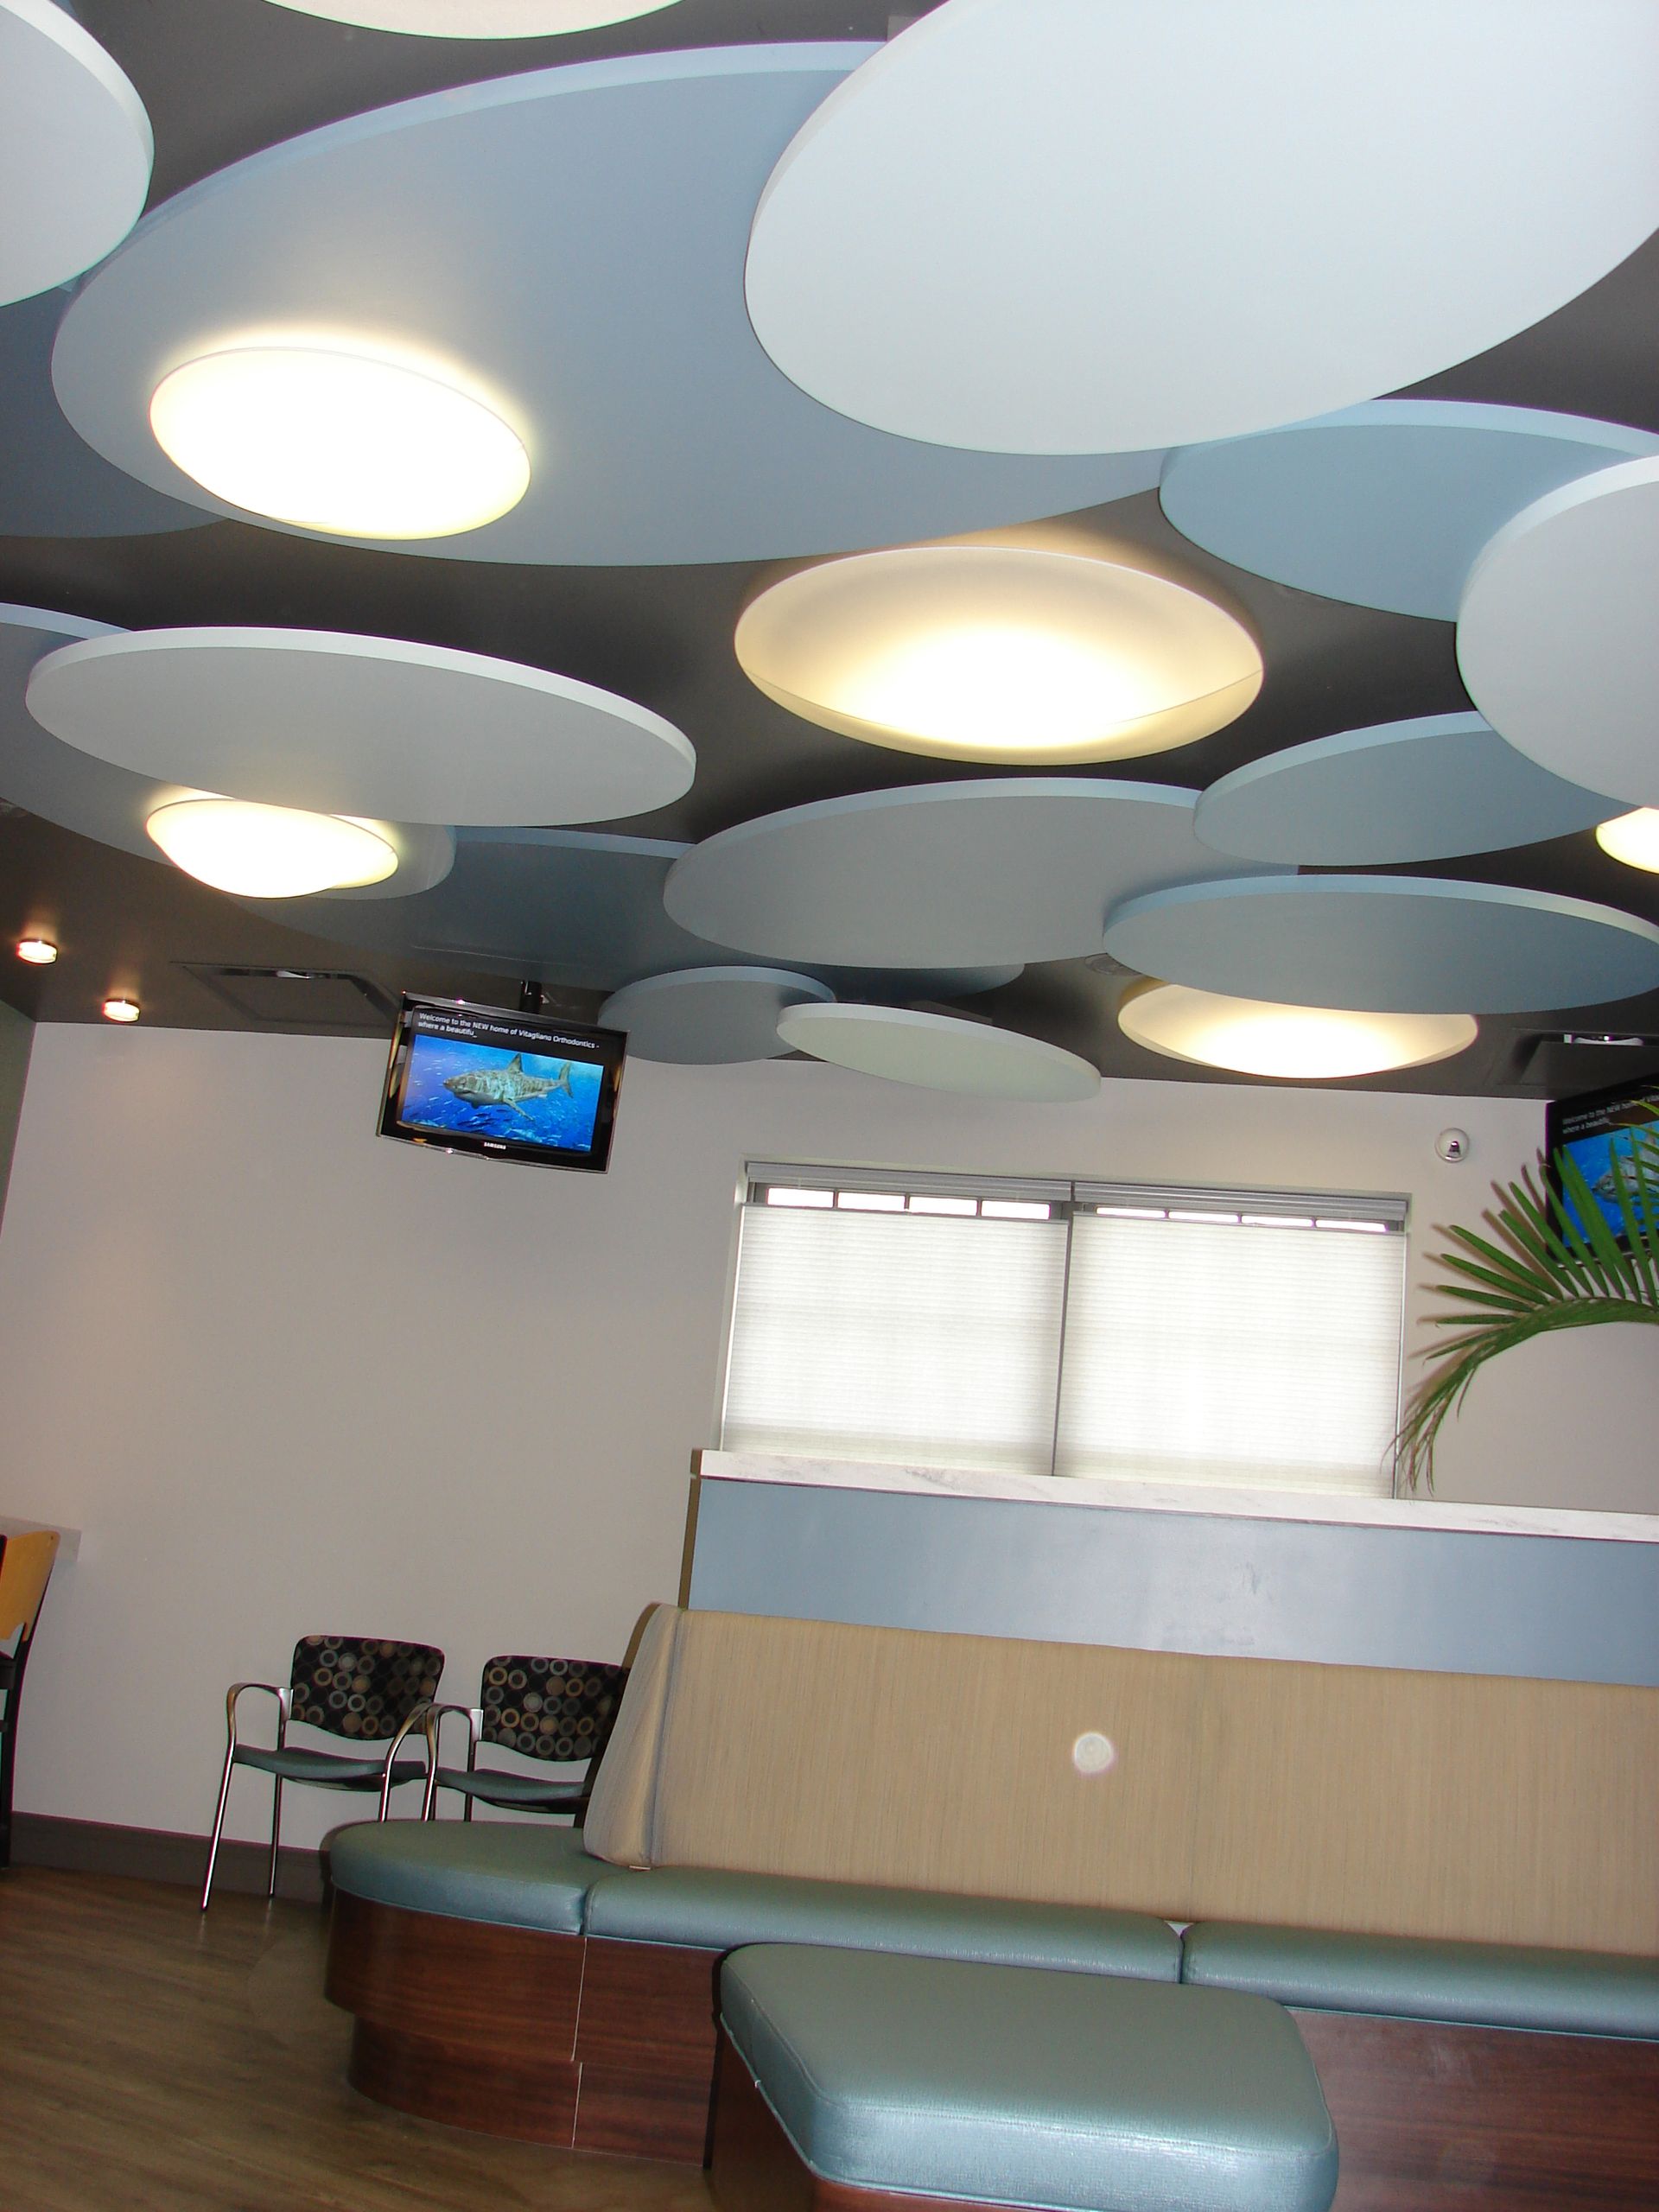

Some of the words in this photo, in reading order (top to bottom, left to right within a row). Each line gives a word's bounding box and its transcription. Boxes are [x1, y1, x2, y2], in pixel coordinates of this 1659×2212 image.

[418, 1020, 439, 1031] where
[419, 1013, 450, 1024] Welcome
[473, 1021, 489, 1030] NEW
[490, 1024, 509, 1034] home
[518, 1029, 552, 1041] Vitagliano
[553, 1035, 595, 1048] Orthodontics
[1562, 1114, 1588, 1125] Welcome
[1606, 1104, 1620, 1113] NEW
